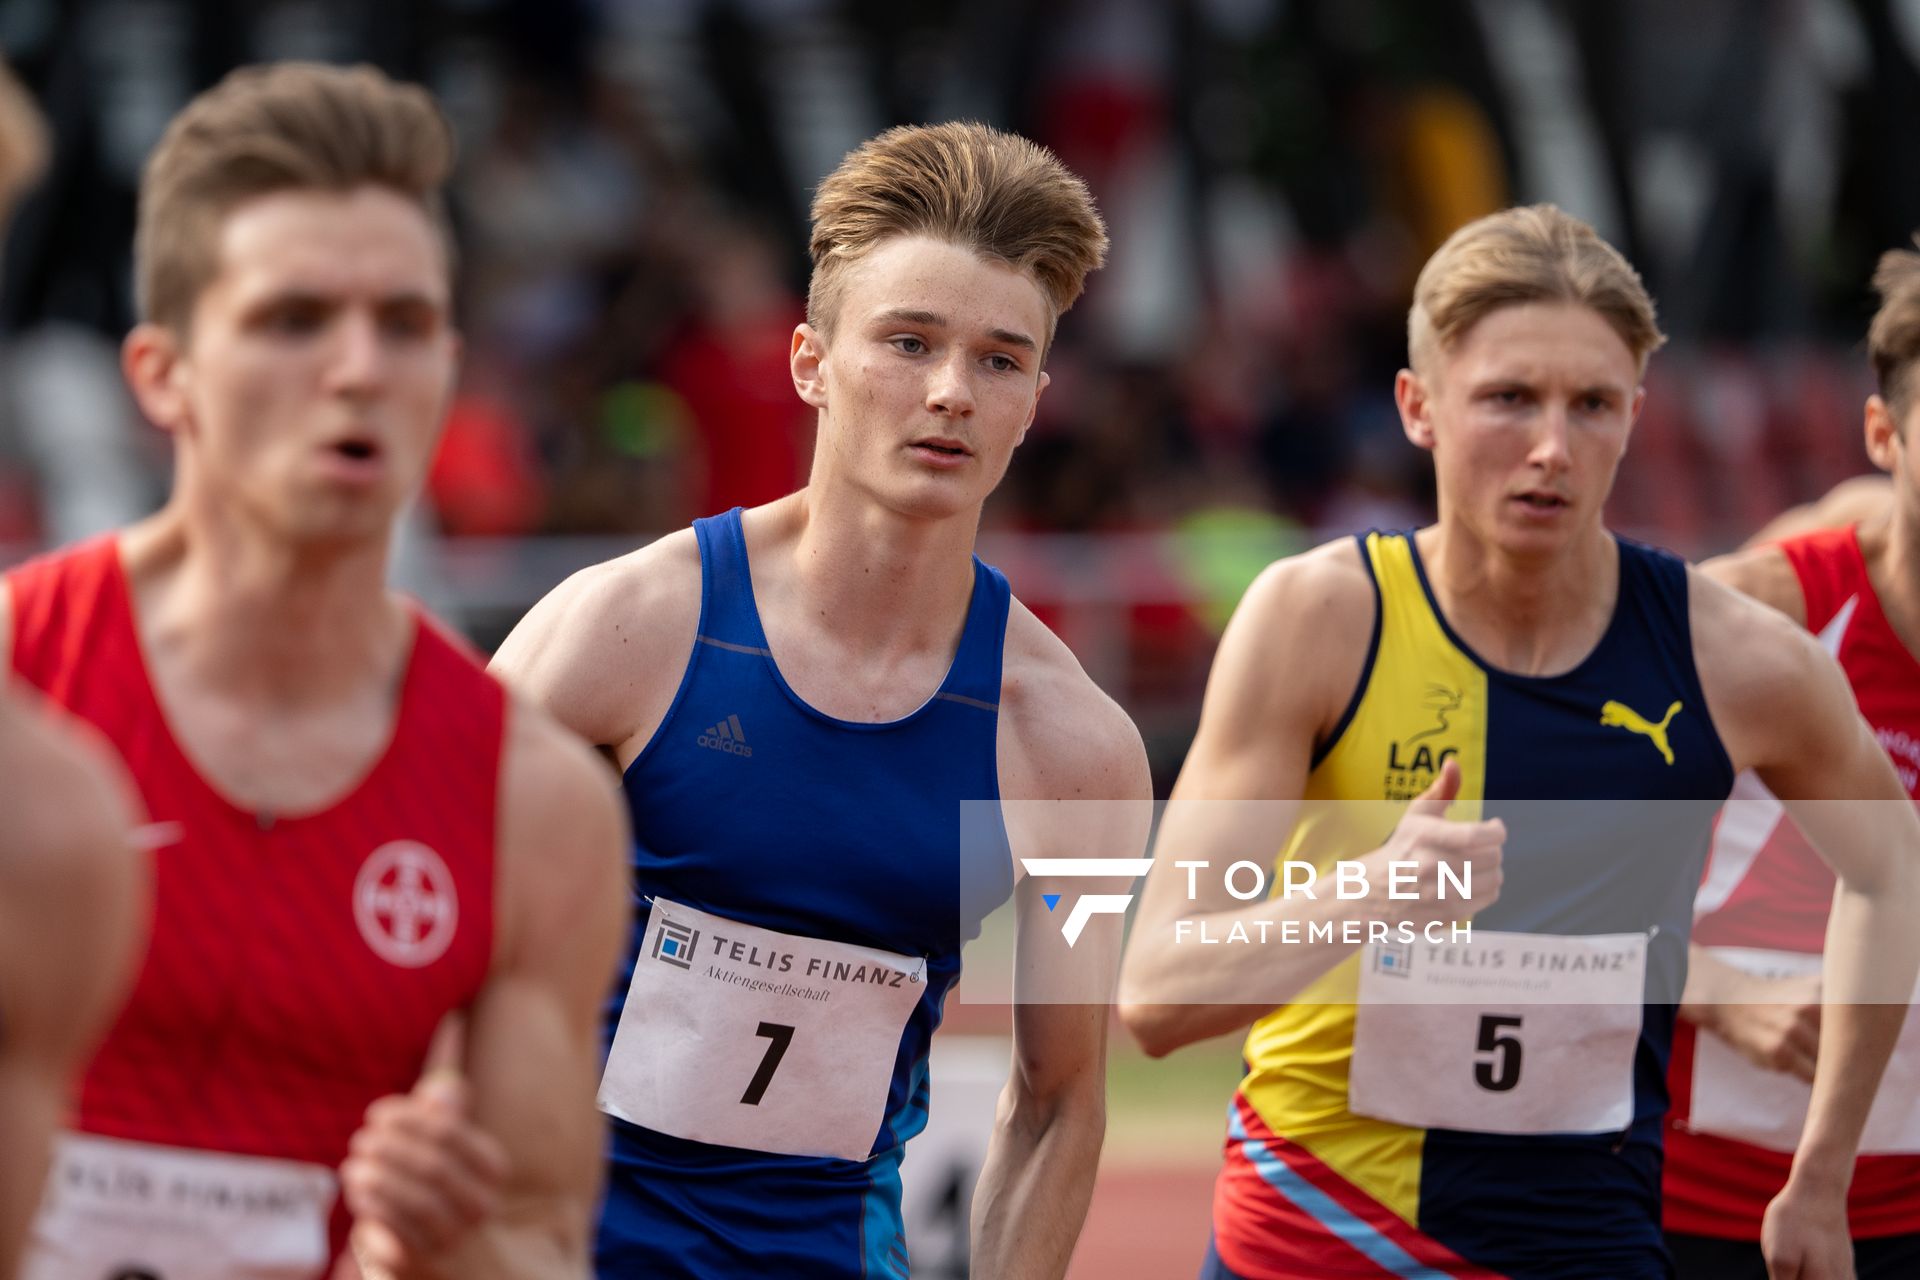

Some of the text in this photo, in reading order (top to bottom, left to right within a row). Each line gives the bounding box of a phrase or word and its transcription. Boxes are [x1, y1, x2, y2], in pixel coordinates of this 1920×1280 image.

[697, 735, 753, 757] adidas
[712, 935, 794, 973] TELIS
[1427, 946, 1505, 969] TELIS
[703, 965, 831, 1002] Aktiengesellschaft
[739, 1021, 796, 1106] 7
[1472, 1012, 1525, 1093] 5
